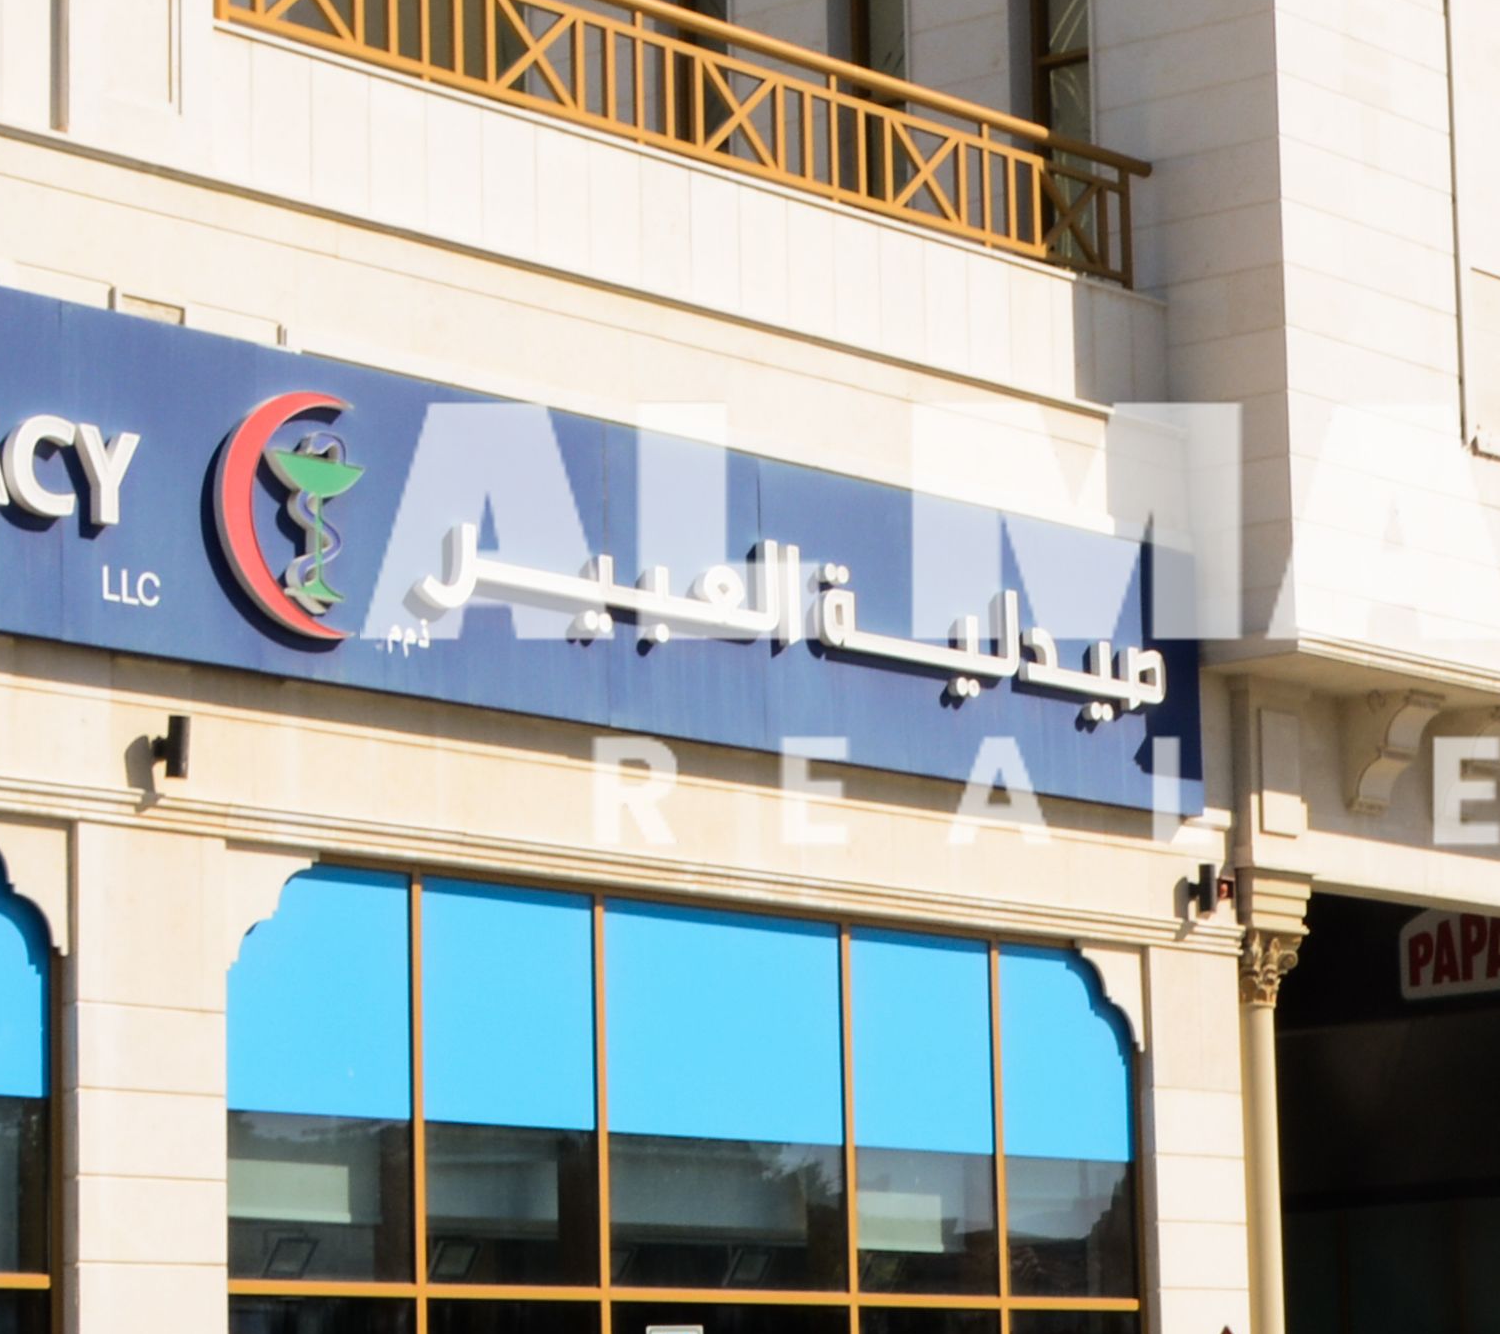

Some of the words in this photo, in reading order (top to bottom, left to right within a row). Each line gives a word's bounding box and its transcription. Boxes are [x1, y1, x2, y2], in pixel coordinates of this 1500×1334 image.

[100, 565, 161, 608] LLC
[419, 522, 801, 646] العبير
[818, 561, 1166, 725] صيدلية
